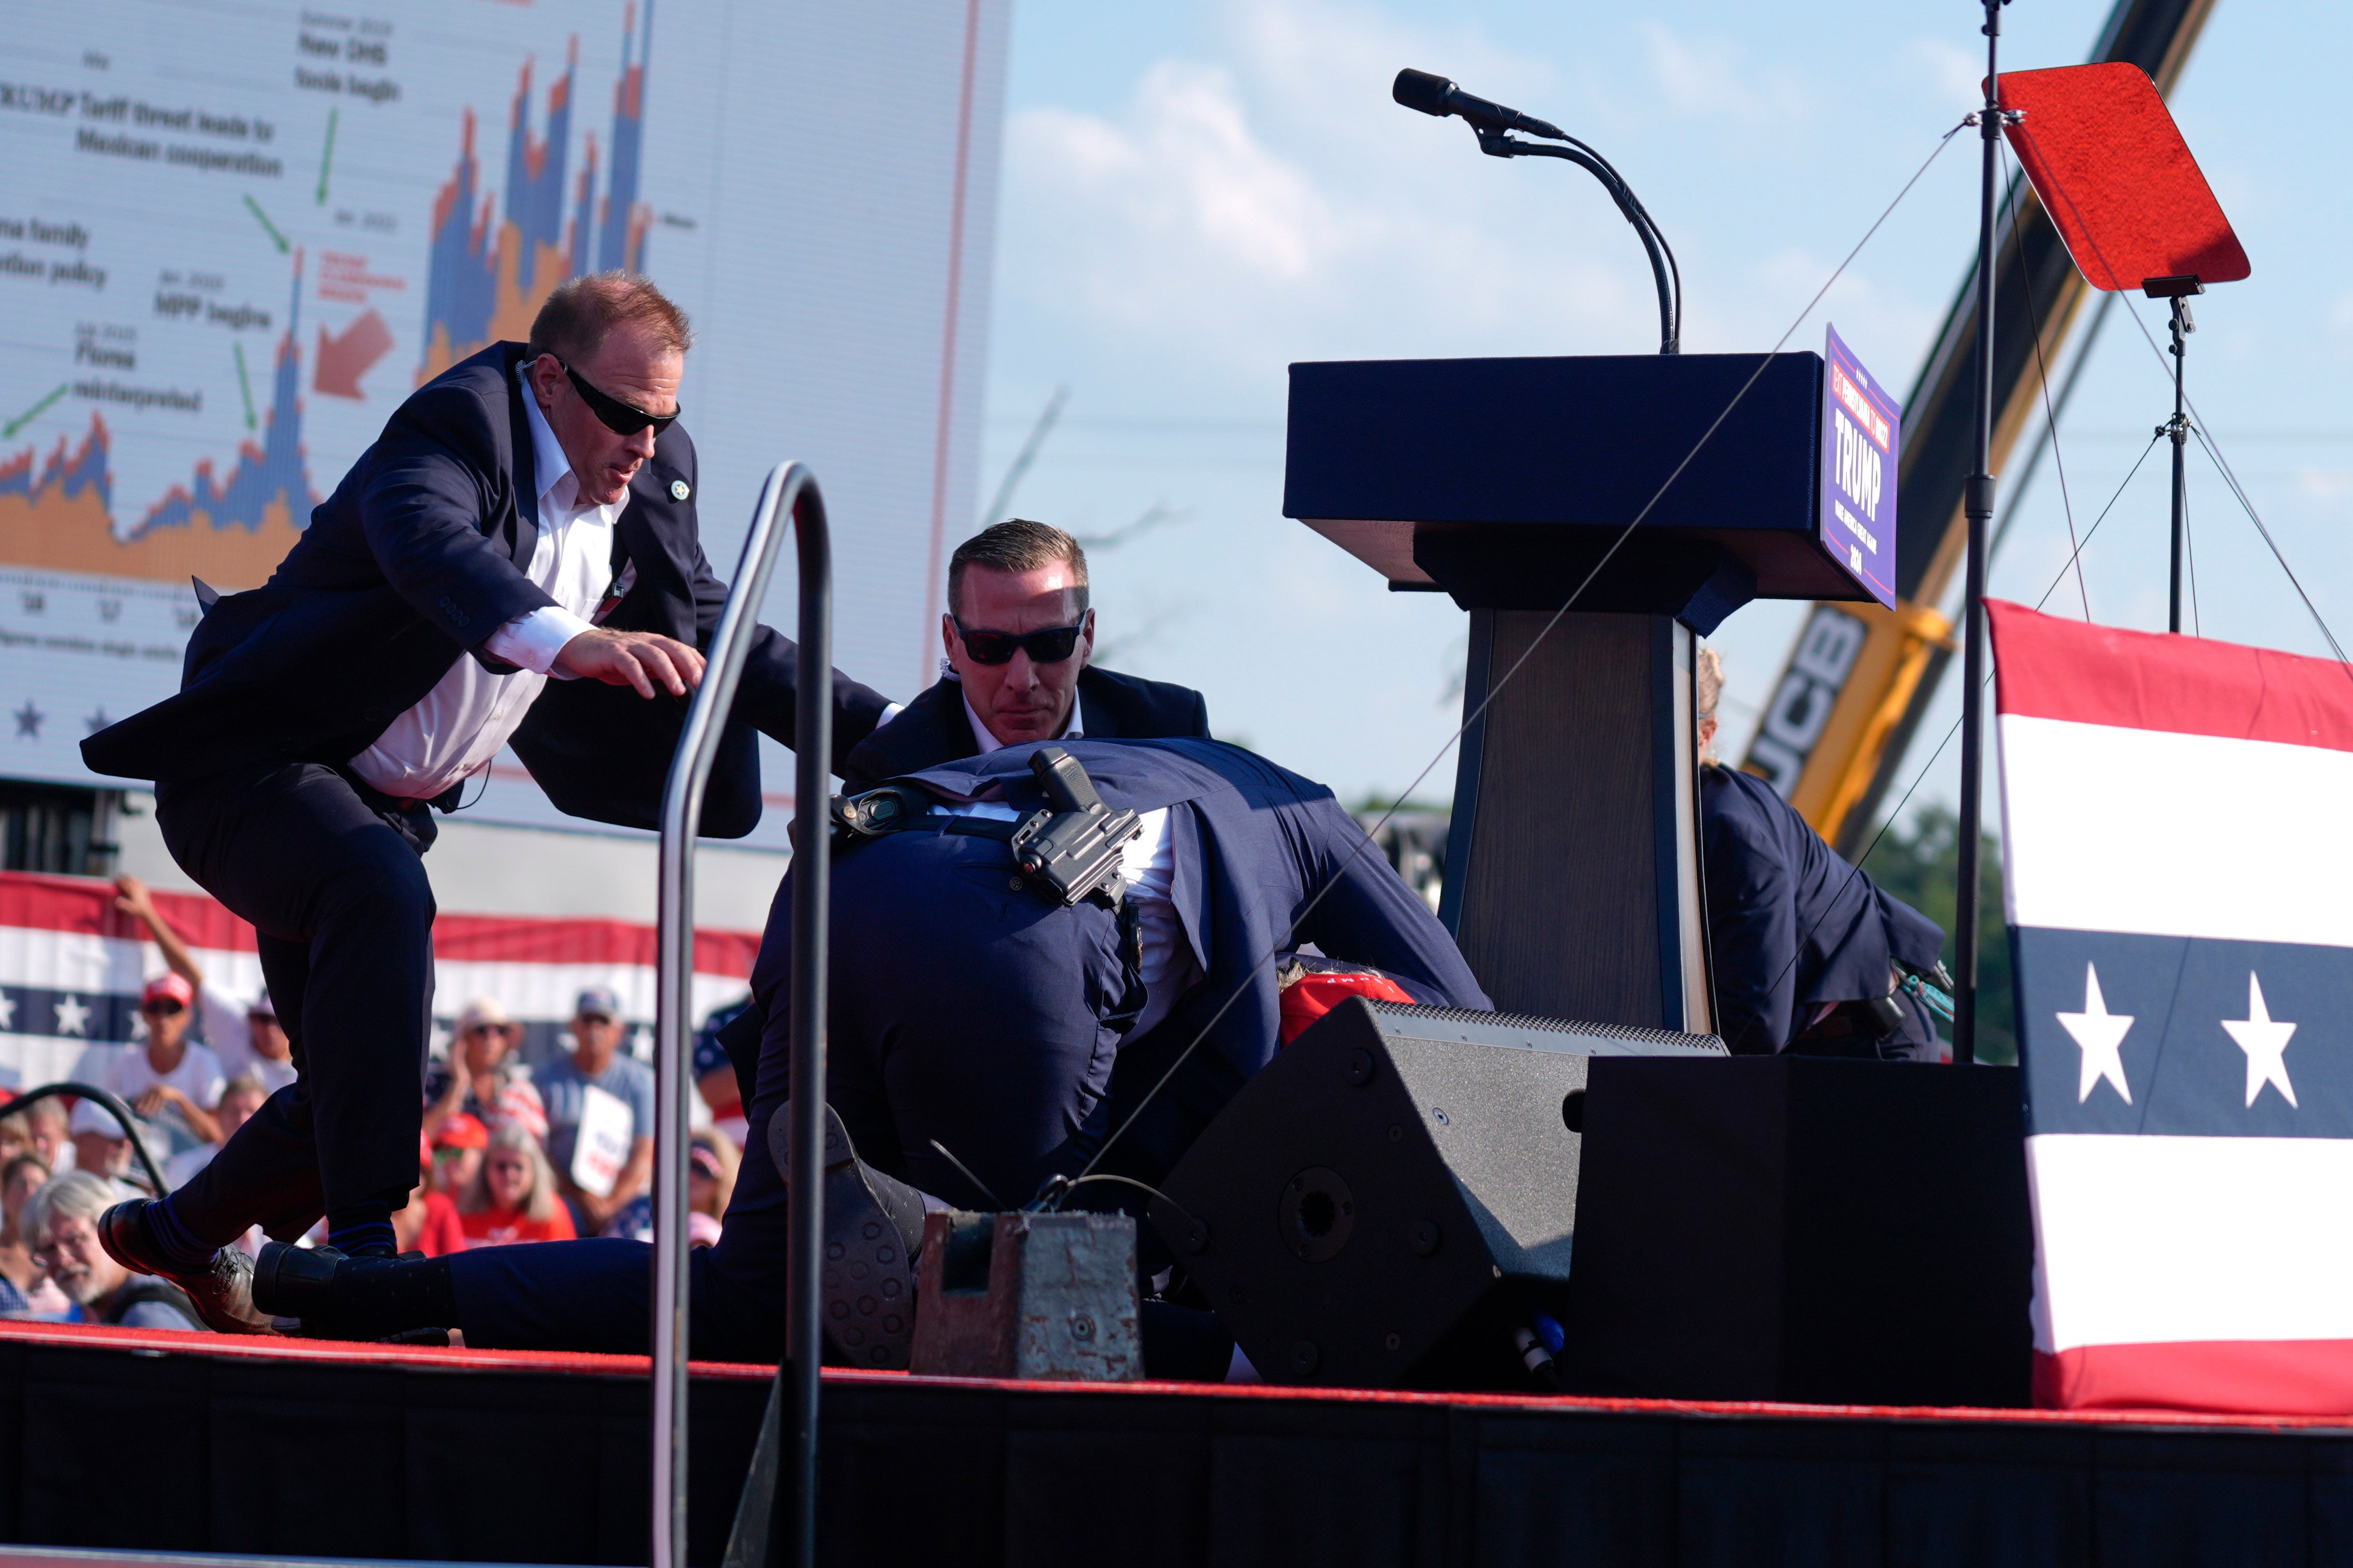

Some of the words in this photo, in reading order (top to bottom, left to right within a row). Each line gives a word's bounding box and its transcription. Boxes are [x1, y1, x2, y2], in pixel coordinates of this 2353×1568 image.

[80, 91, 129, 122] Tariff
[134, 101, 193, 131] threat
[254, 118, 274, 143] to
[75, 127, 160, 162] Mexican
[167, 142, 283, 178] cooperation
[30, 217, 88, 250] family
[51, 259, 107, 291] policy
[1870, 409, 1876, 436] TO
[1836, 407, 1881, 522] TRUMP
[1835, 499, 1844, 522] MAKE
[1844, 509, 1857, 535] AMERICA
[1857, 522, 1867, 544] GREAT
[1850, 544, 1862, 575] 2024
[1748, 605, 1868, 802] JCB
